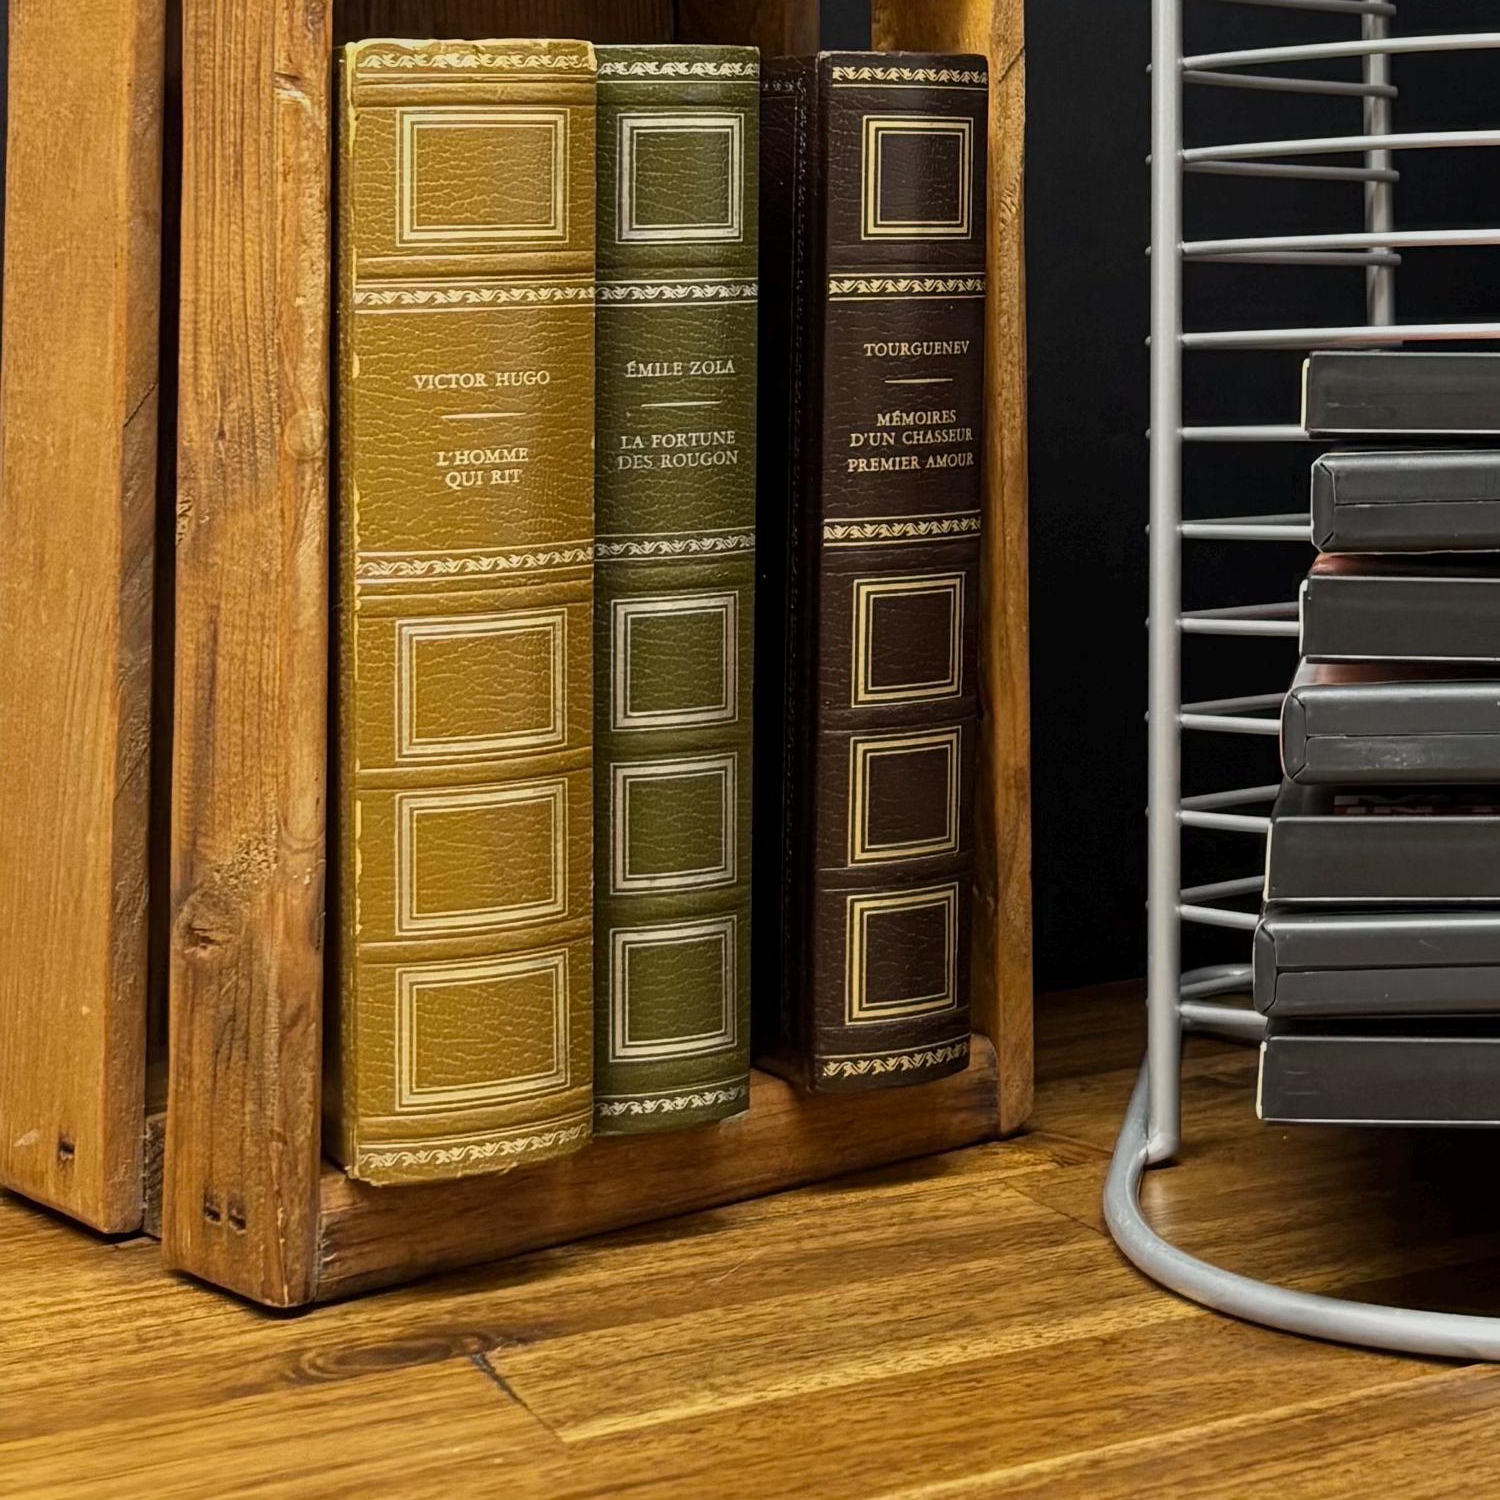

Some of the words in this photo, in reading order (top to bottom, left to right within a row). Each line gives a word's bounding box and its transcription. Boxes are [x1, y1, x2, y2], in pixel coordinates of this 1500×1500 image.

[863, 340, 970, 357] TOURGUENEV
[625, 360, 683, 378] ÉMILE
[689, 360, 736, 375] ZOLA
[413, 372, 488, 389] VICTOR
[495, 370, 550, 387] HUGO
[876, 410, 957, 427] MÉMOIRES
[620, 435, 645, 449] LA
[651, 430, 736, 448] FORTUNE
[850, 432, 896, 448] D'UN
[902, 428, 974, 445] CHASSEUR
[436, 448, 529, 466] L'HOMME
[617, 455, 653, 470] DES
[660, 450, 739, 469] ROUGON
[847, 456, 921, 472] PREMIER
[925, 452, 974, 469] AMOUR
[445, 470, 483, 490] QUI
[490, 469, 524, 485] RIT
